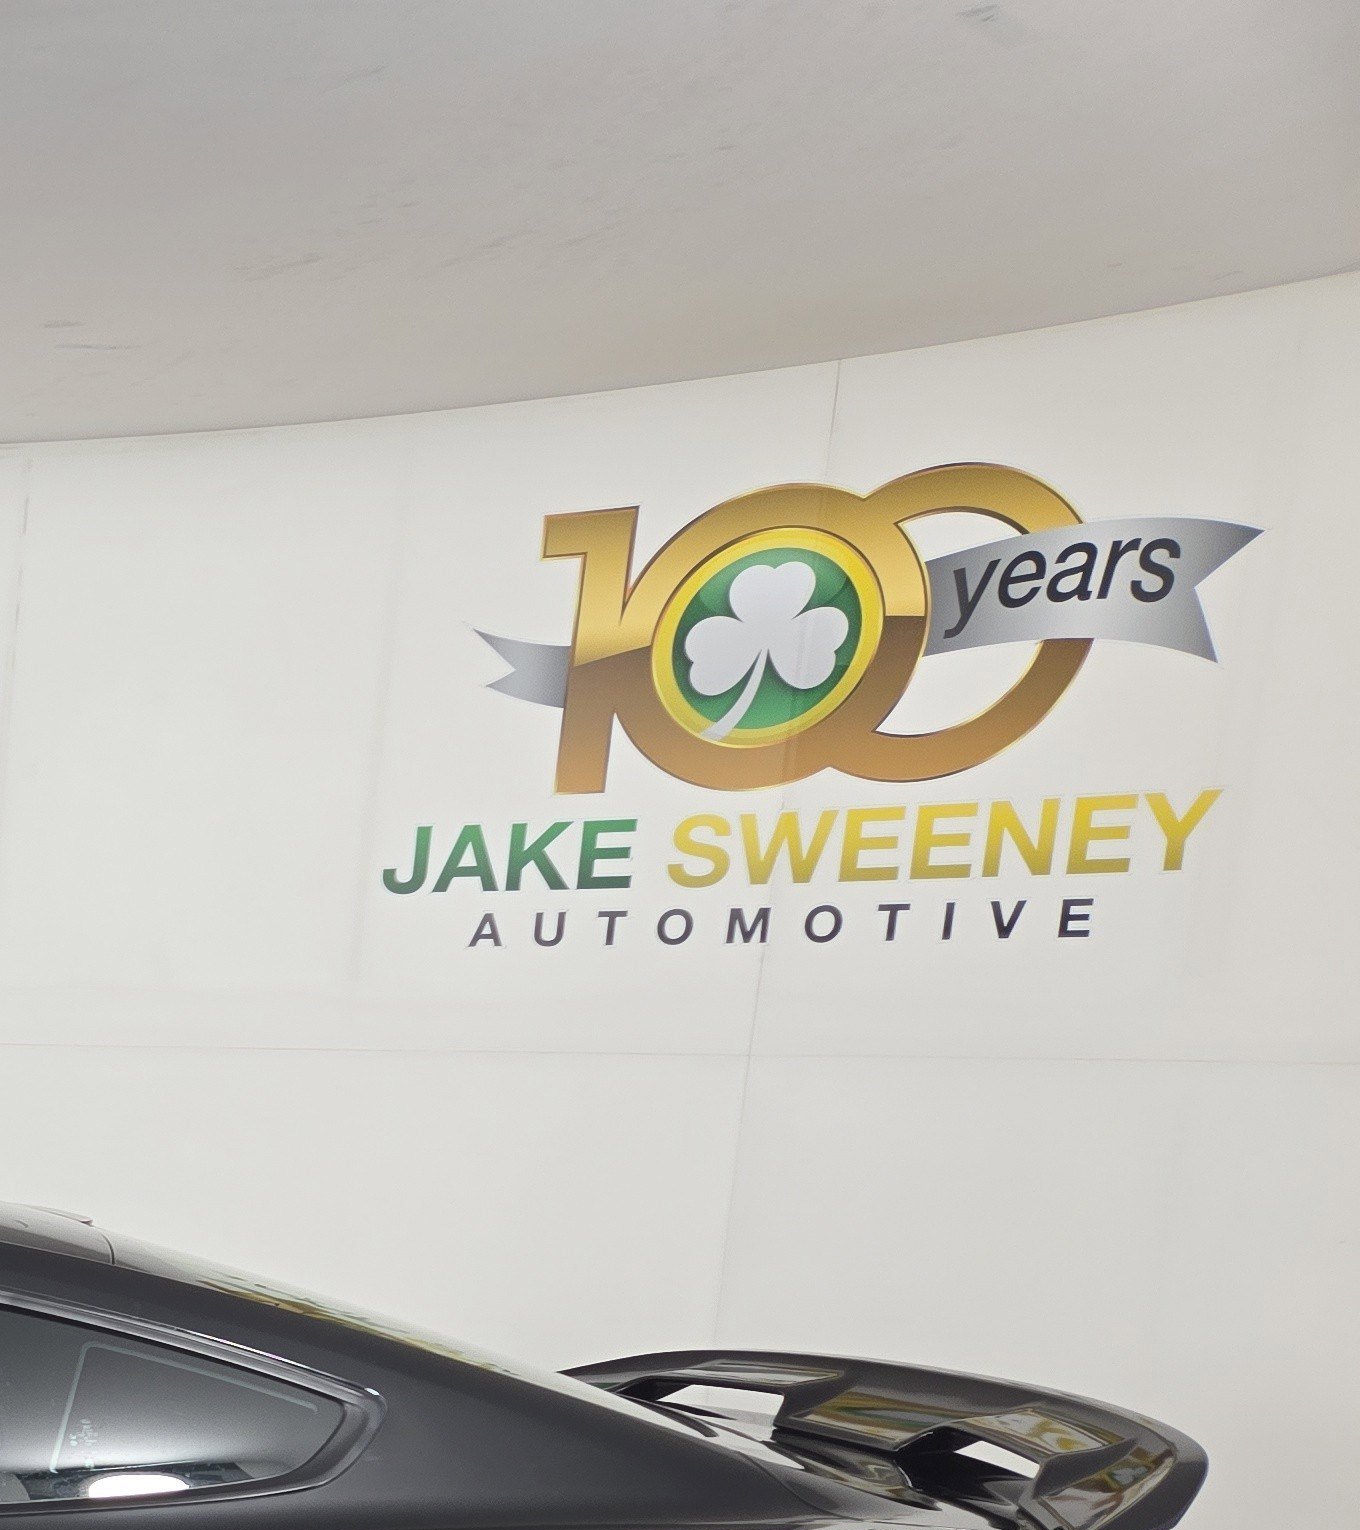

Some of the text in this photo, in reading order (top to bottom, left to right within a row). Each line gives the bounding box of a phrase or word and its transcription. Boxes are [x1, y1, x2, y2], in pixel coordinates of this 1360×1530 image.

[542, 461, 1182, 796] 100 years
[381, 788, 1223, 895] JAKE SWEENEY
[469, 898, 1094, 948] AUTOMOTIVE
